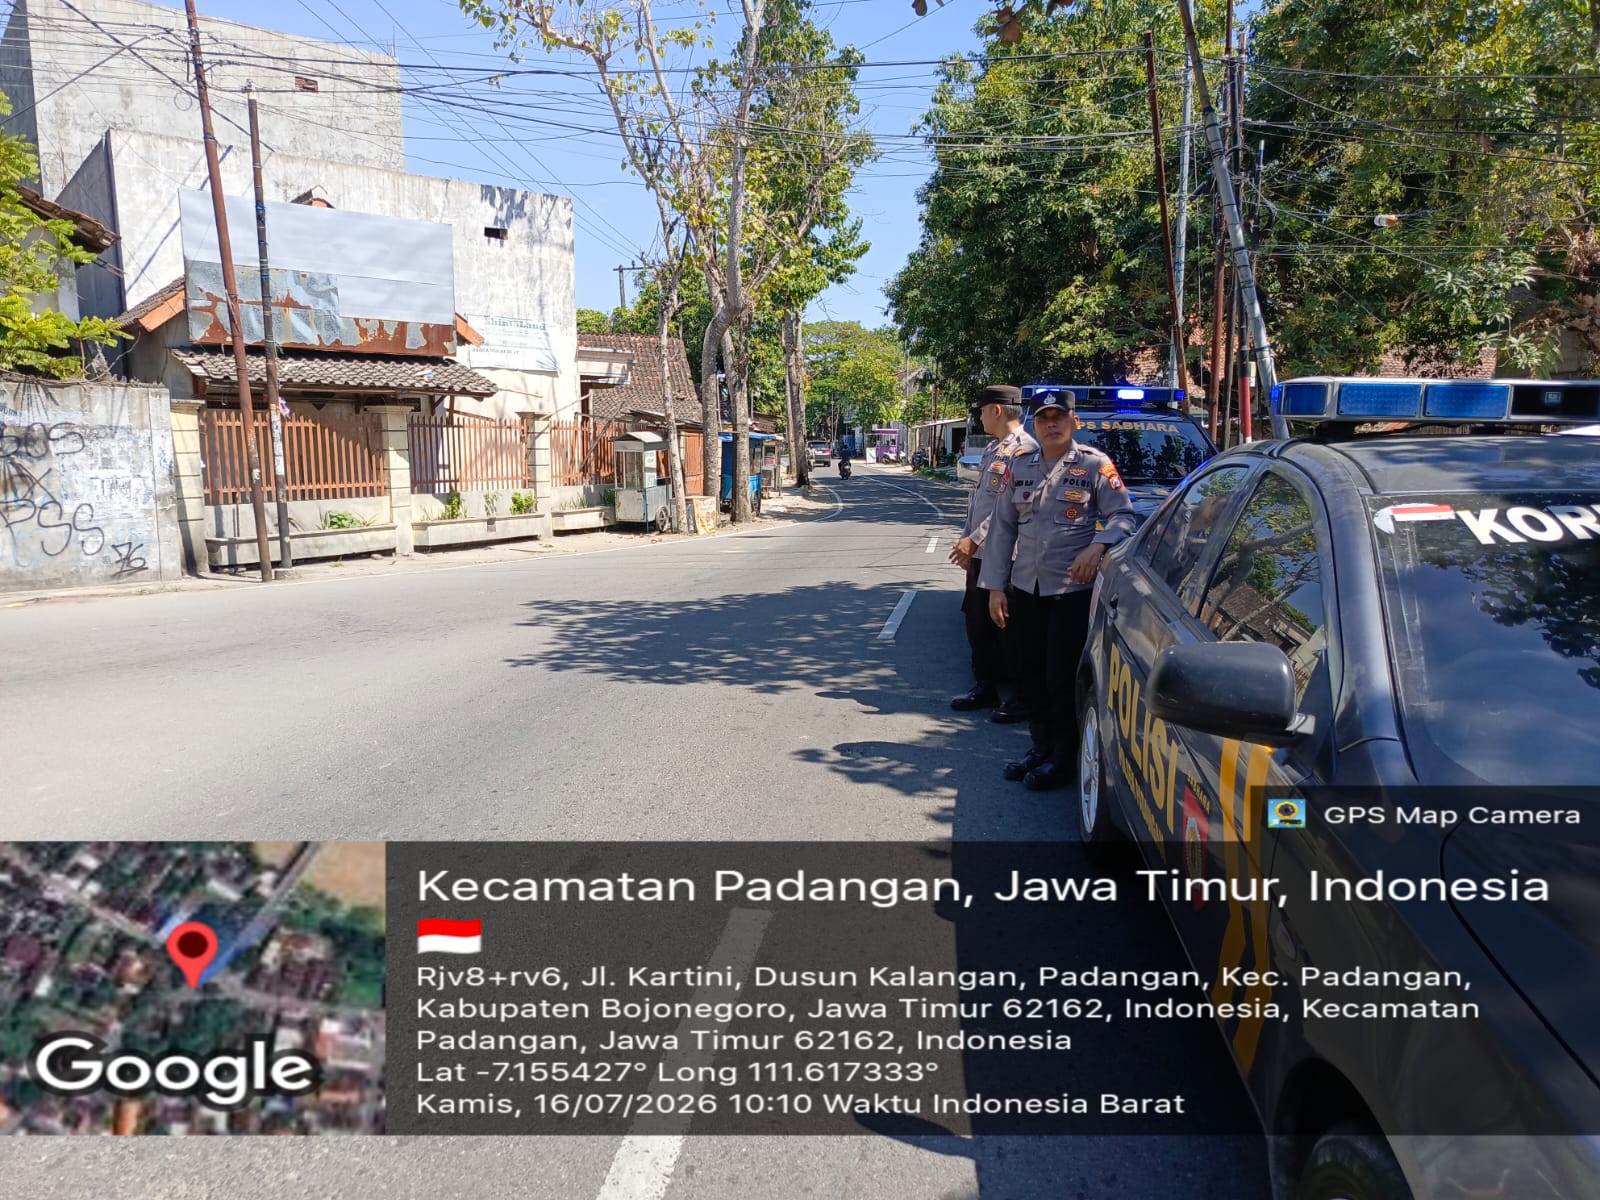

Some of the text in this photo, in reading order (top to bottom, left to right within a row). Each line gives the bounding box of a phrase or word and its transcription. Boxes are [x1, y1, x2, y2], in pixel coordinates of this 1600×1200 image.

[1101, 421, 1179, 433] SABHARA
[1063, 478, 1090, 488] POLRI
[1456, 504, 1600, 545] KOR
[1107, 642, 1179, 835] POLISI
